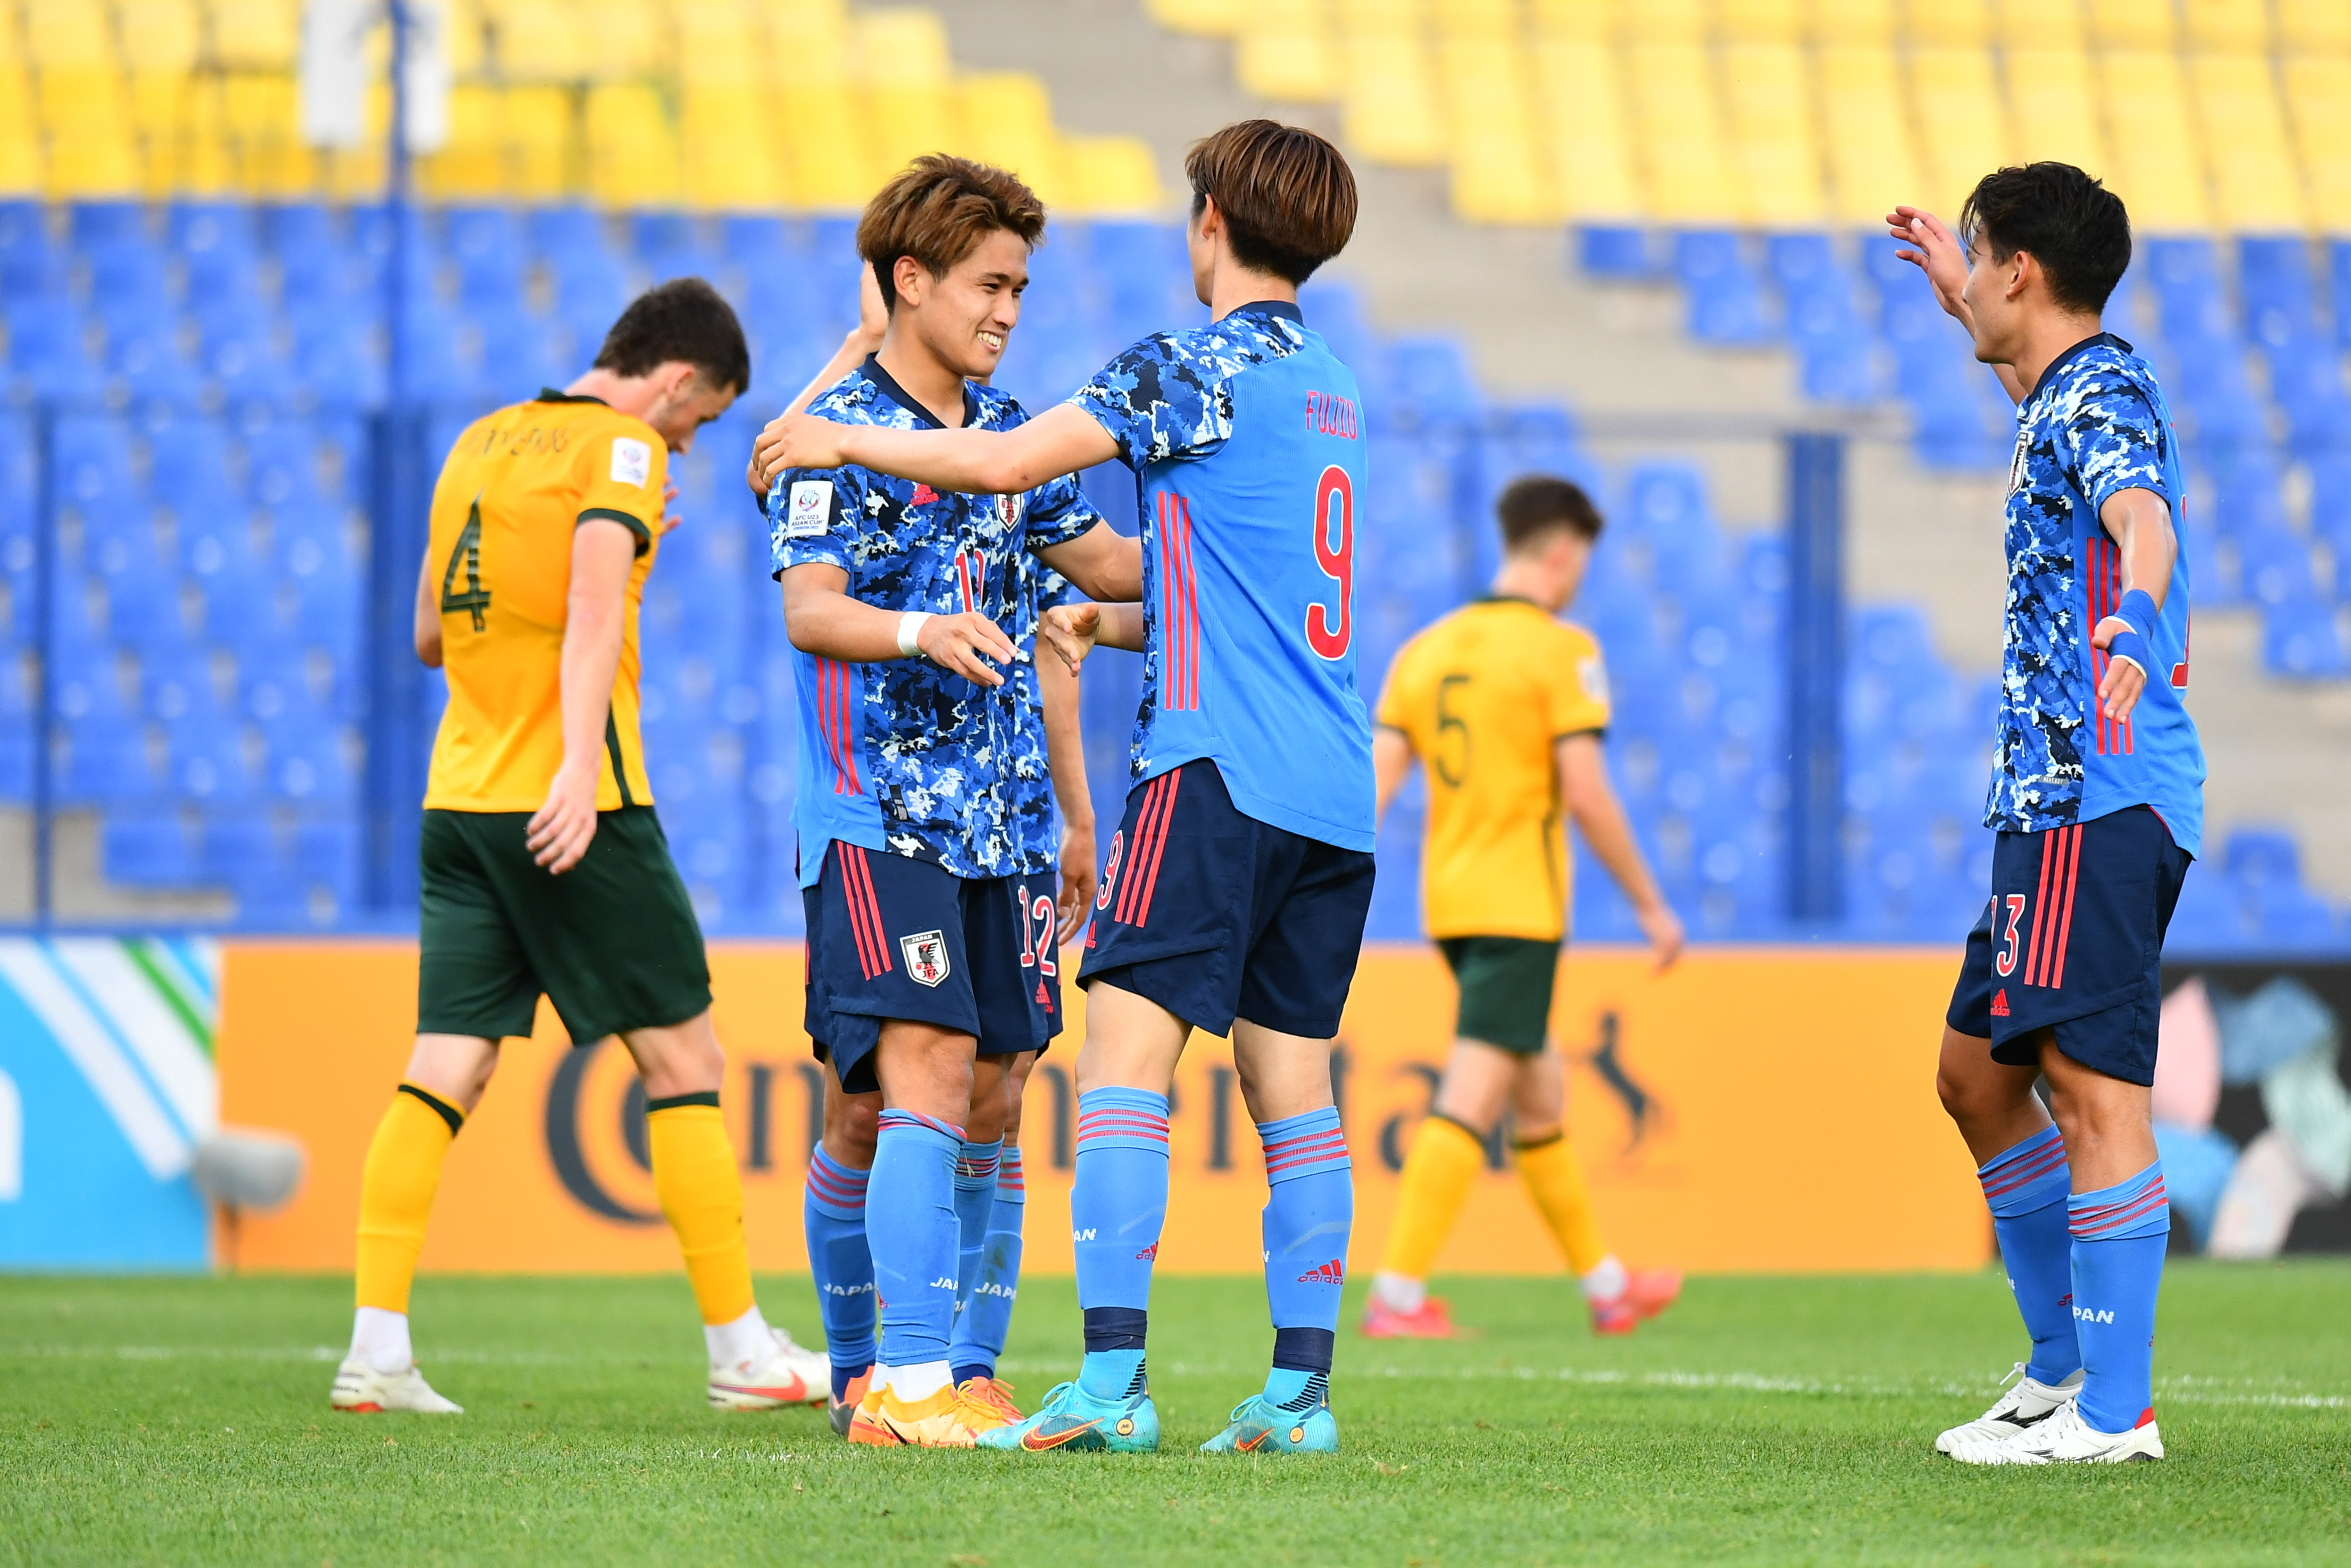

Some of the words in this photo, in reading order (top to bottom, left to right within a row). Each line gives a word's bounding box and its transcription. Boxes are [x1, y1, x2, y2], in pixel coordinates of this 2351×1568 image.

[1305, 390, 1357, 440] FUJIO
[441, 489, 492, 633] 4
[1305, 464, 1354, 661] 9
[1435, 673, 1471, 788] 5
[1096, 830, 1123, 910] 9
[911, 934, 933, 943] JAPAN
[1018, 885, 1056, 977] 12
[922, 968, 939, 978] JFA
[823, 1282, 878, 1296] JAPA
